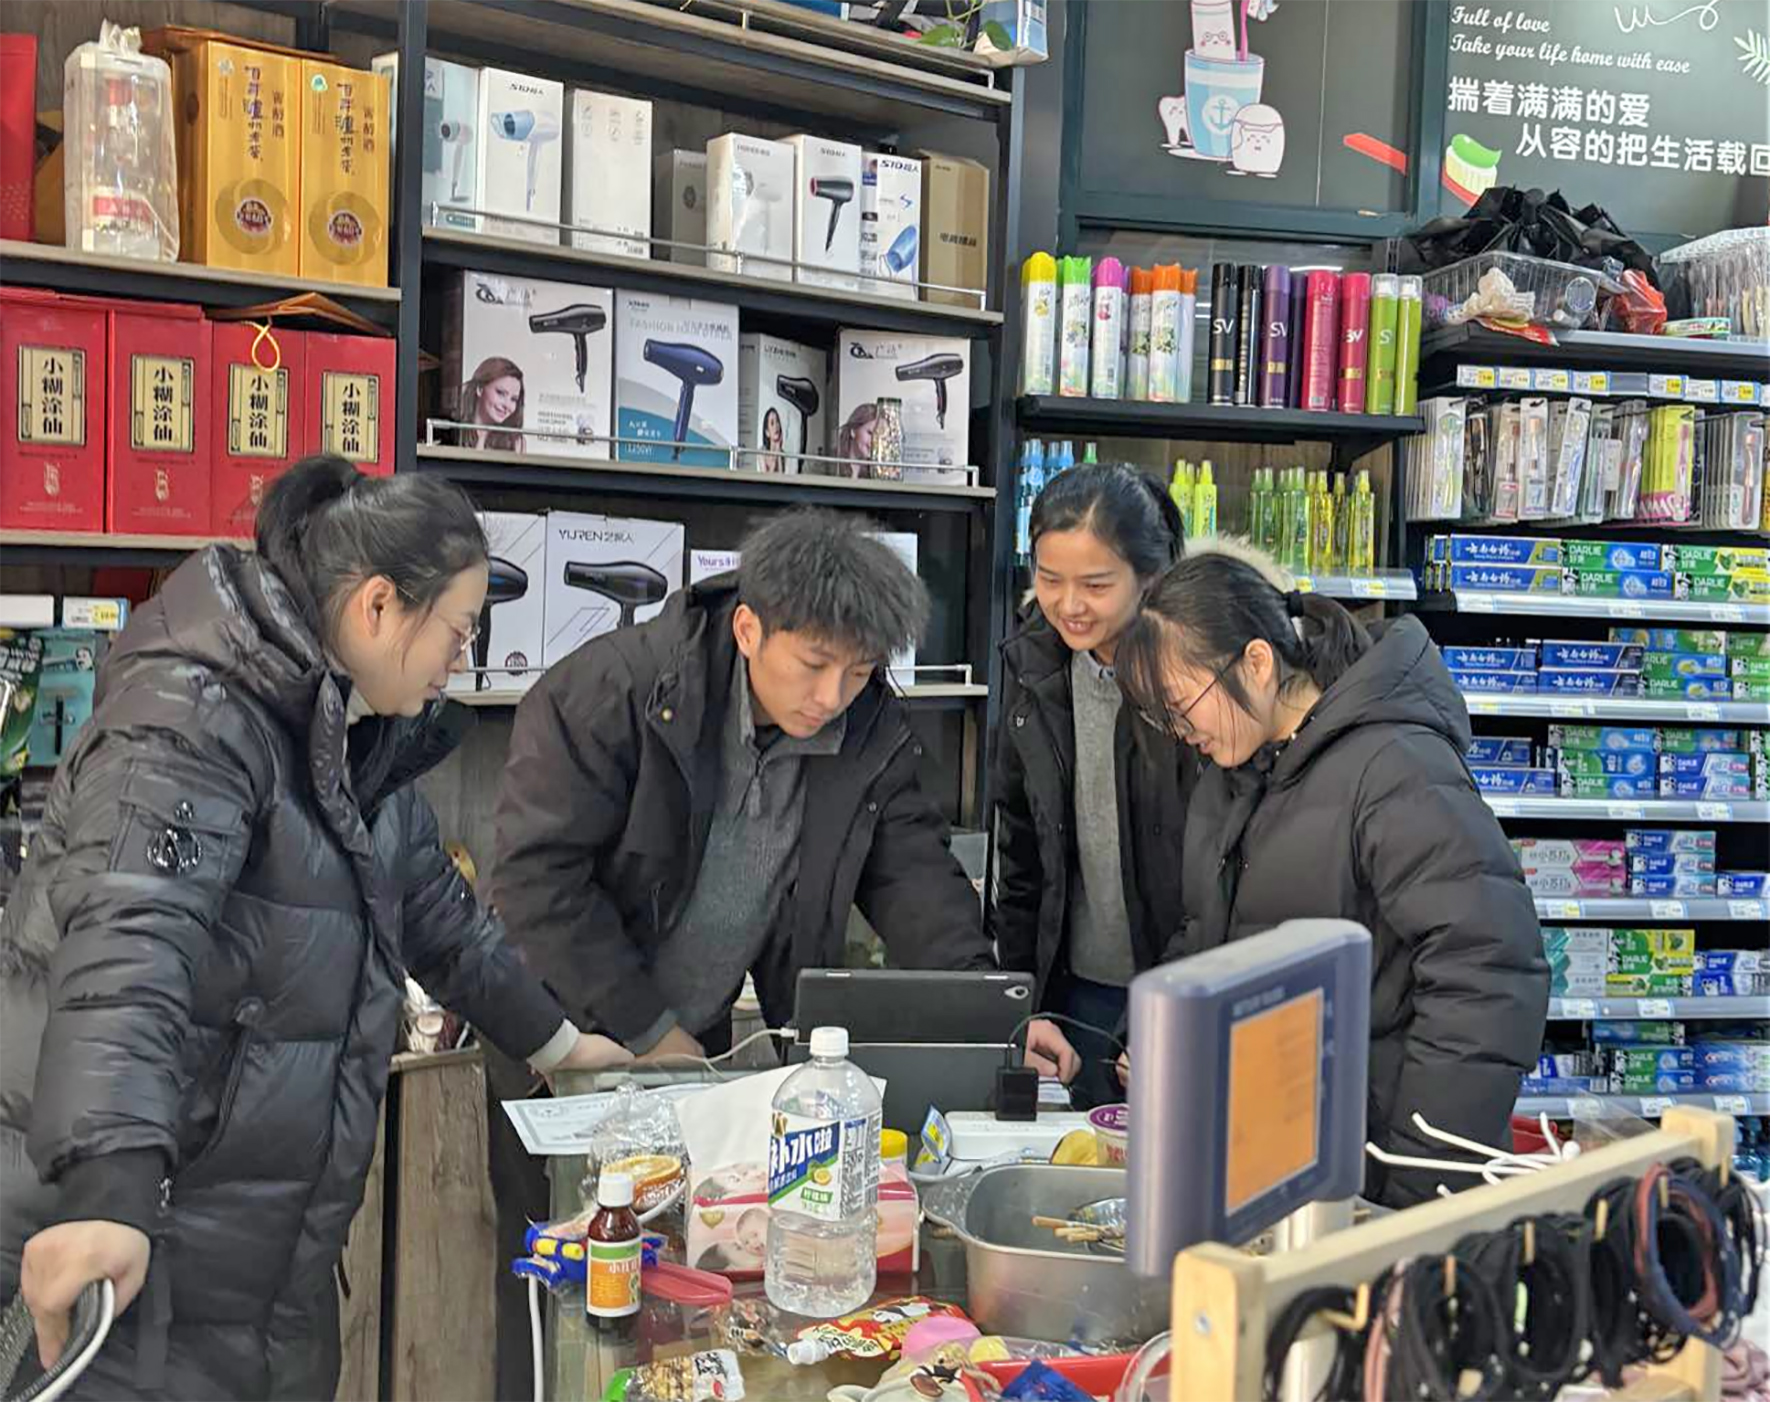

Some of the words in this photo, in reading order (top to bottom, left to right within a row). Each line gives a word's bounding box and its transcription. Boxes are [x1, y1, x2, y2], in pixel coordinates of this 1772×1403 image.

[1451, 6, 1488, 28] Full
[1492, 11, 1513, 33] of
[1514, 16, 1551, 33] love
[1450, 34, 1491, 54] Take
[1495, 44, 1535, 61] your
[1539, 42, 1568, 66] life
[1570, 46, 1614, 67] home
[1617, 51, 1652, 70] with
[1656, 57, 1690, 74] ease
[1448, 76, 1651, 128] 揣着满满的爱
[1212, 318, 1234, 335] SV
[42, 357, 64, 435] 小糊涂仙
[153, 365, 173, 442] 小糊涂仙
[249, 373, 269, 449] 小糊涂仙
[341, 381, 361, 454] 小糊涂仙
[1569, 544, 1602, 556] DARLIE
[1681, 549, 1712, 560] DARLIE
[1581, 573, 1613, 584] DARLIE
[1693, 577, 1726, 588] DARLIE
[1650, 678, 1678, 688] DARLIE
